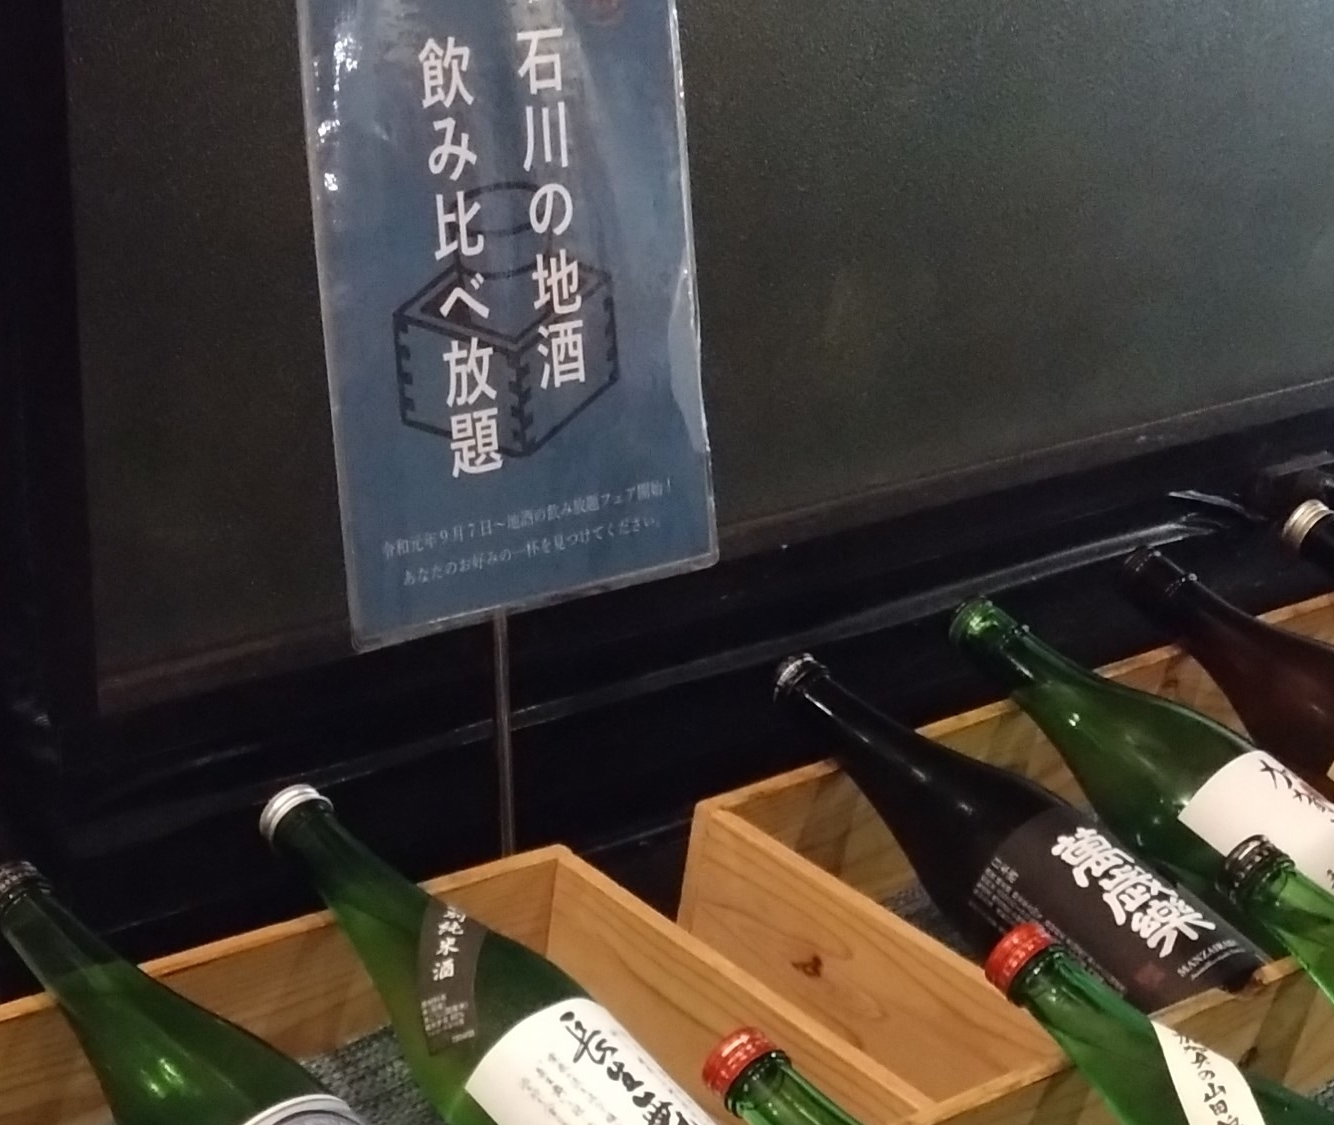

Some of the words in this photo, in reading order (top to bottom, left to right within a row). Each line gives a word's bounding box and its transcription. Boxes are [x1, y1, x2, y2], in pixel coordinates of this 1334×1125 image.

[418, 36, 504, 479] 飲み比べ放題
[516, 27, 587, 390] 石川の地酒
